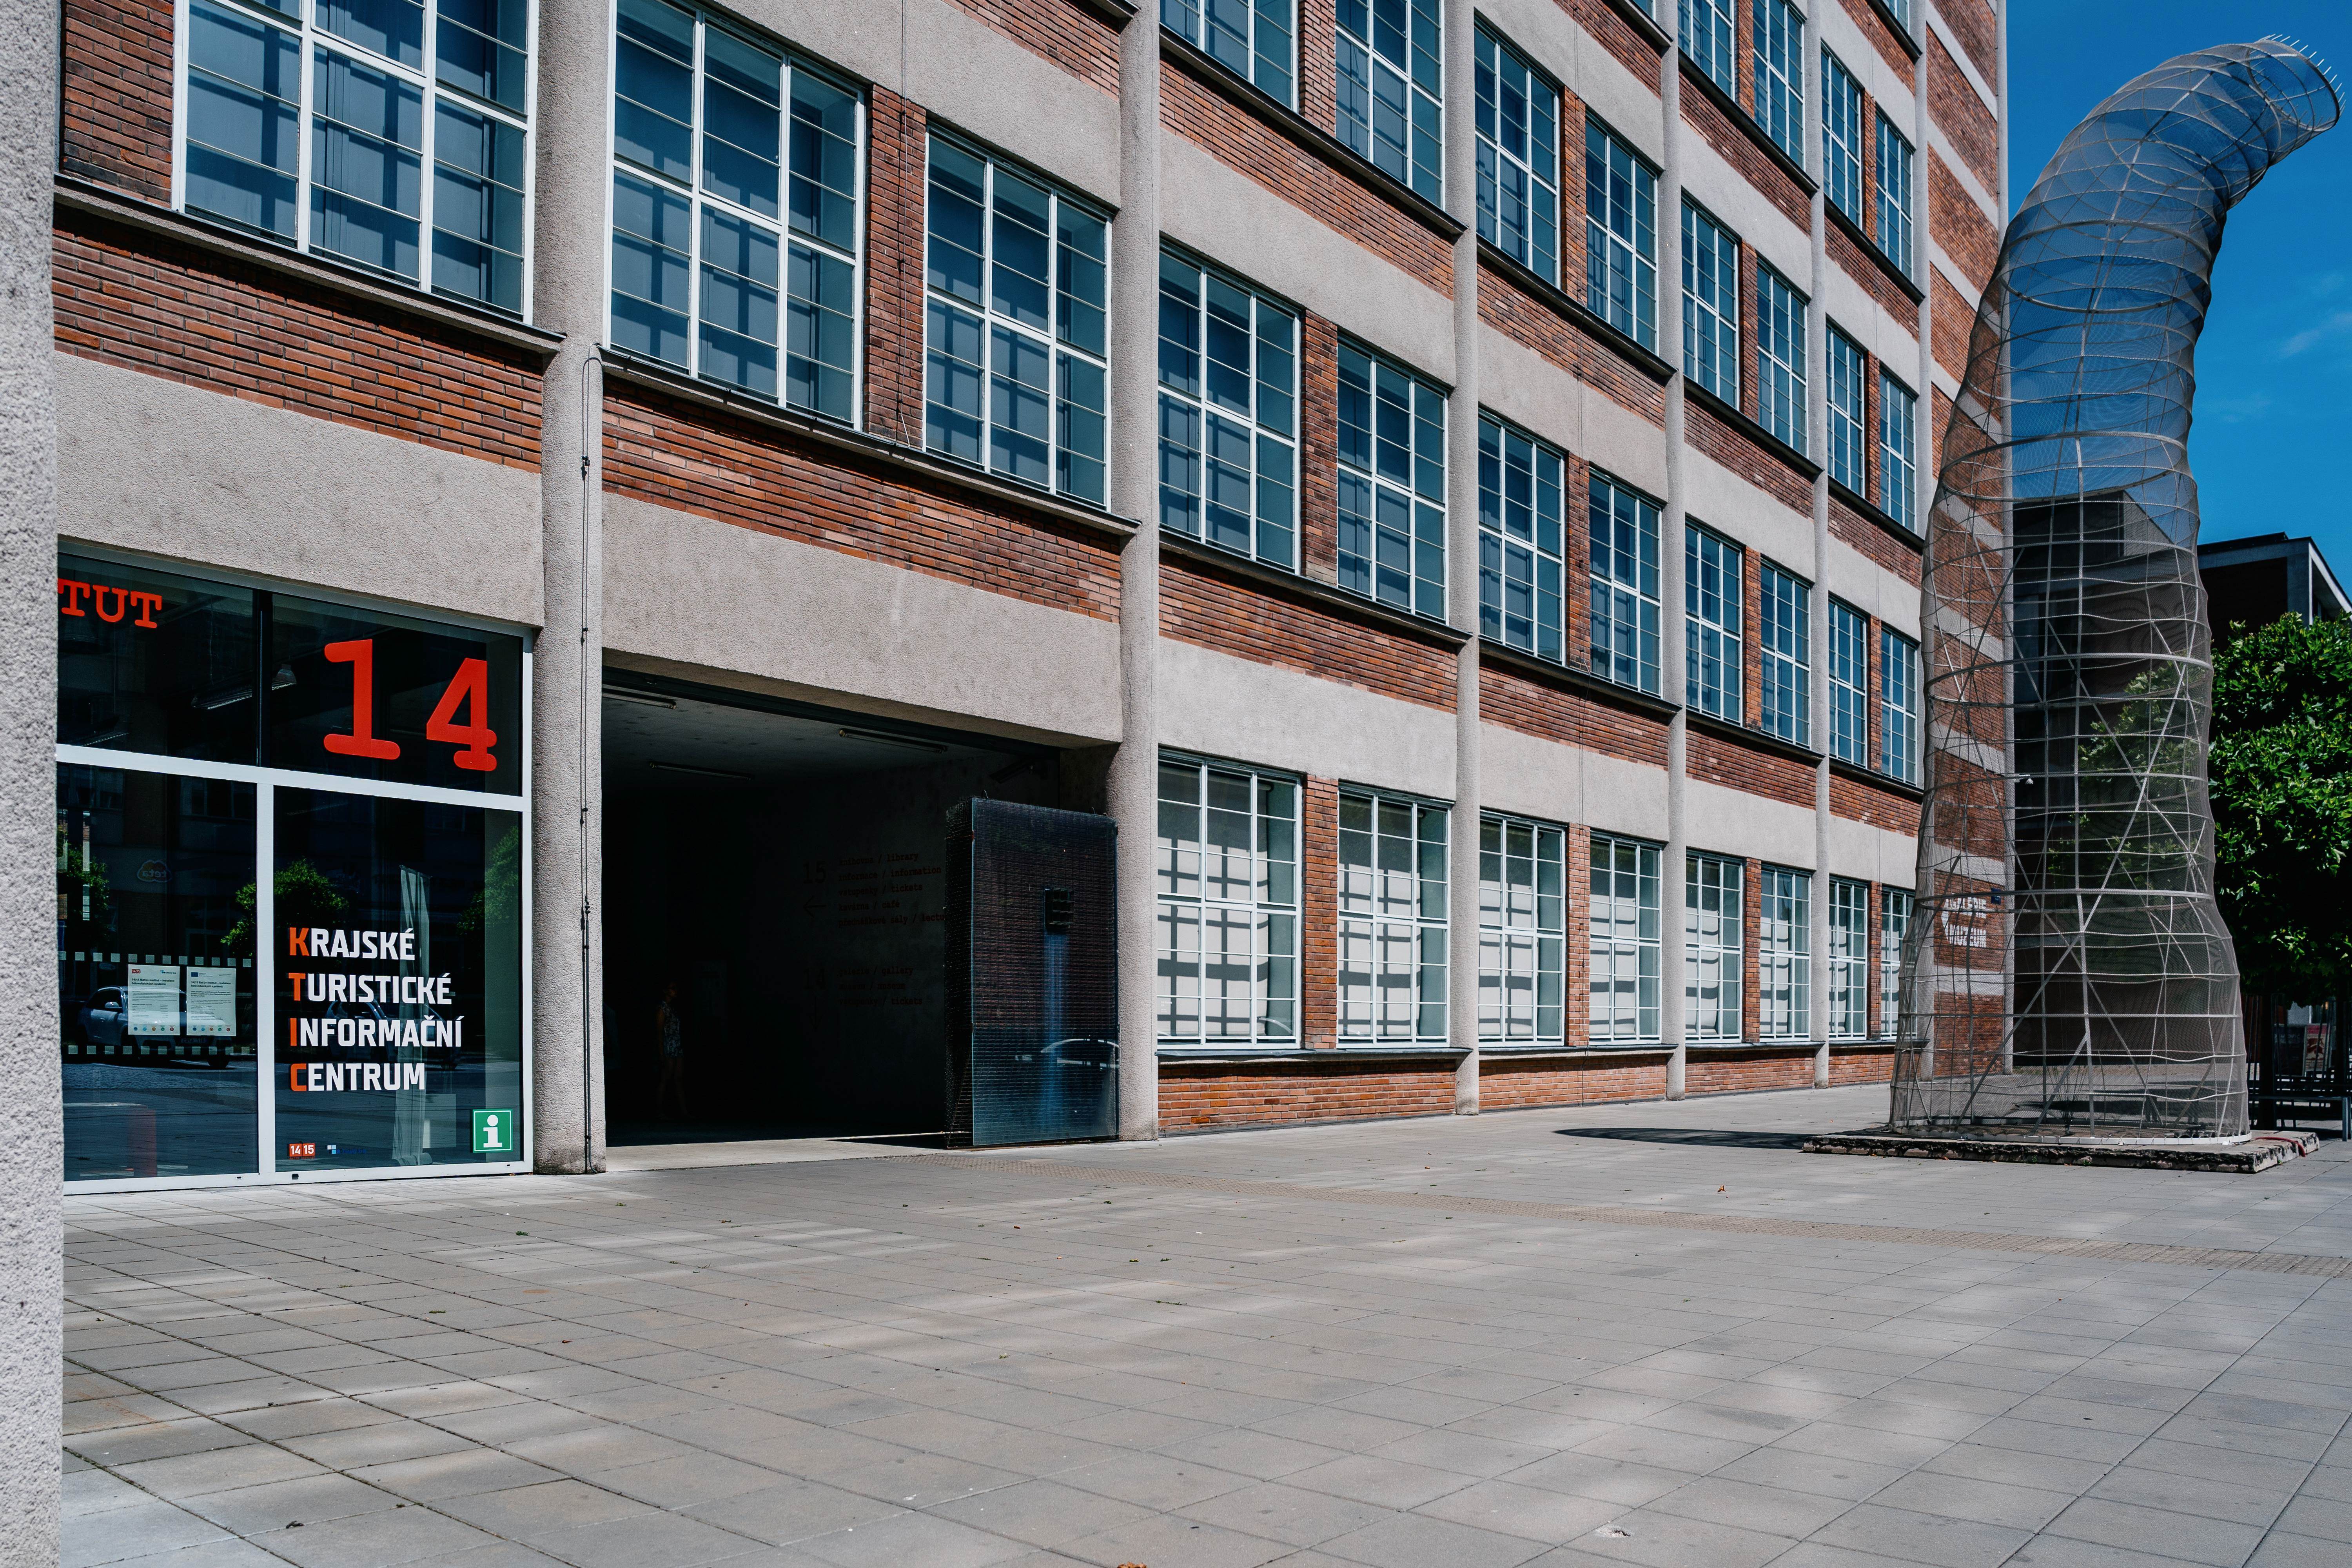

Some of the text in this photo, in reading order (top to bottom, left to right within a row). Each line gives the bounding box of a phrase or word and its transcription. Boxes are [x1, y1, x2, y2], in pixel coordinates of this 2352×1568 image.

[58, 578, 162, 628] TUT
[323, 639, 497, 771] 14
[887, 853, 919, 863] library
[891, 866, 942, 877] information
[891, 883, 923, 893] tickets
[289, 927, 416, 960] KRAJSKÉ
[289, 973, 452, 1004] TURISTICKÉ
[891, 996, 923, 1005] tickets
[290, 1015, 465, 1047] INFORMAČNÍ
[290, 1063, 425, 1091] CENTRUM
[290, 1145, 314, 1155] 14 15
